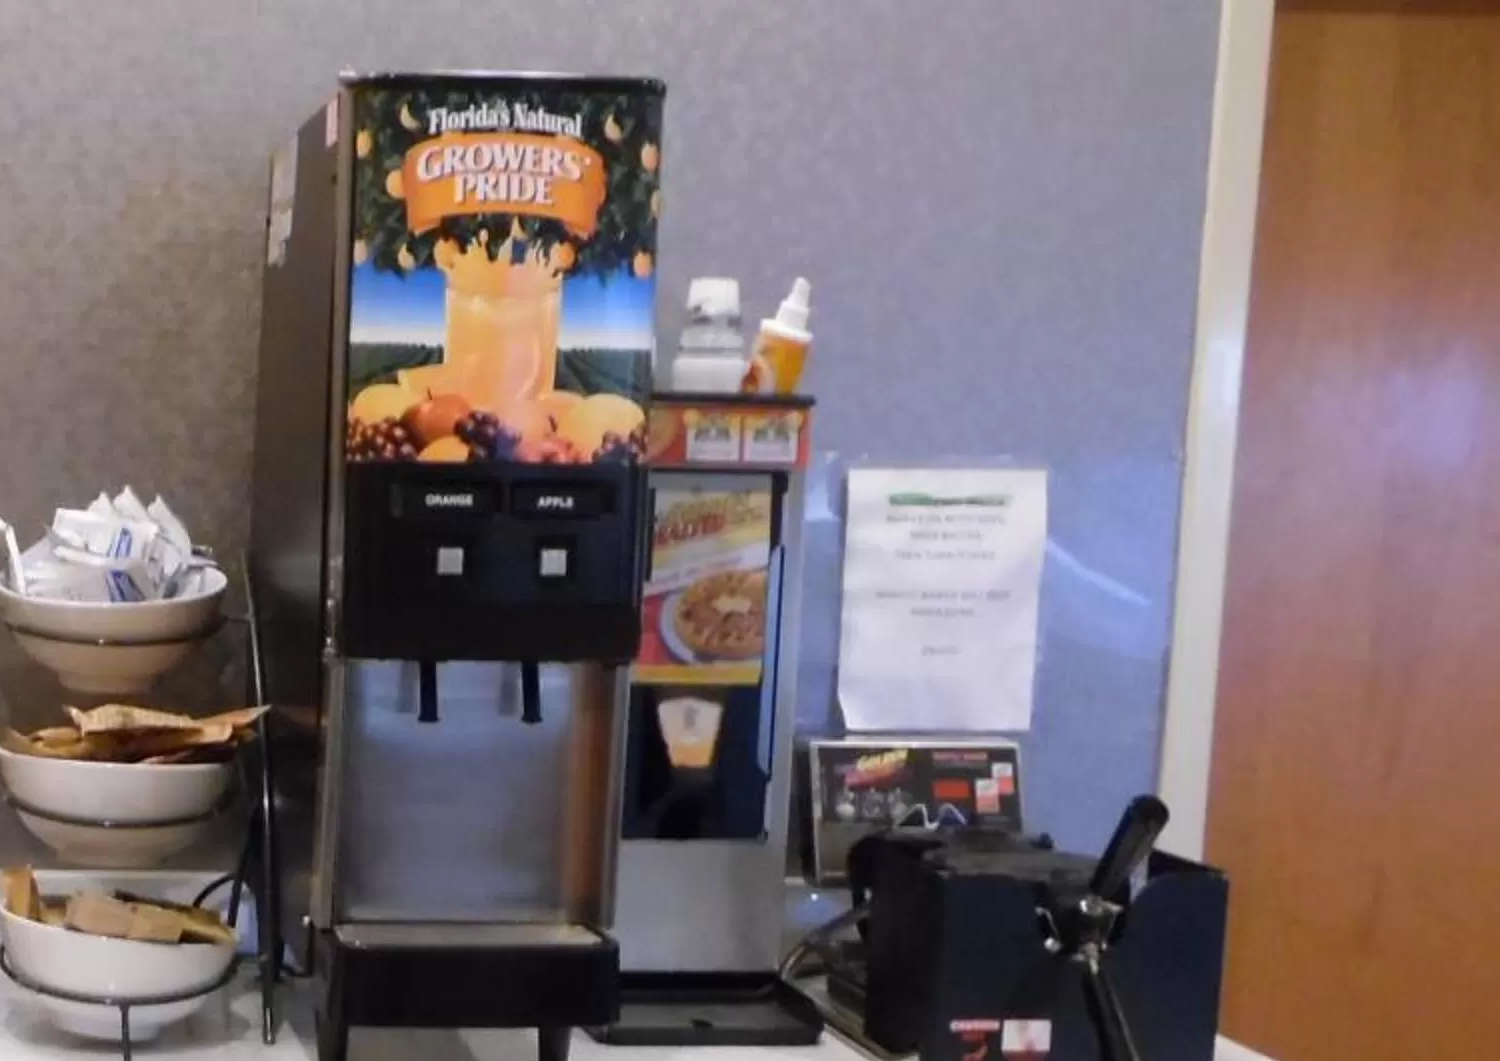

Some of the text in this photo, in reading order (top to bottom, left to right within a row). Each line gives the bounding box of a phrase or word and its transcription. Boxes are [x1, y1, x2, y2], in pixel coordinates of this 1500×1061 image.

[428, 101, 582, 137] Florida's Natural
[455, 172, 553, 204] PRIDE
[425, 494, 473, 507] ORANGE
[537, 496, 573, 508] APPLE
